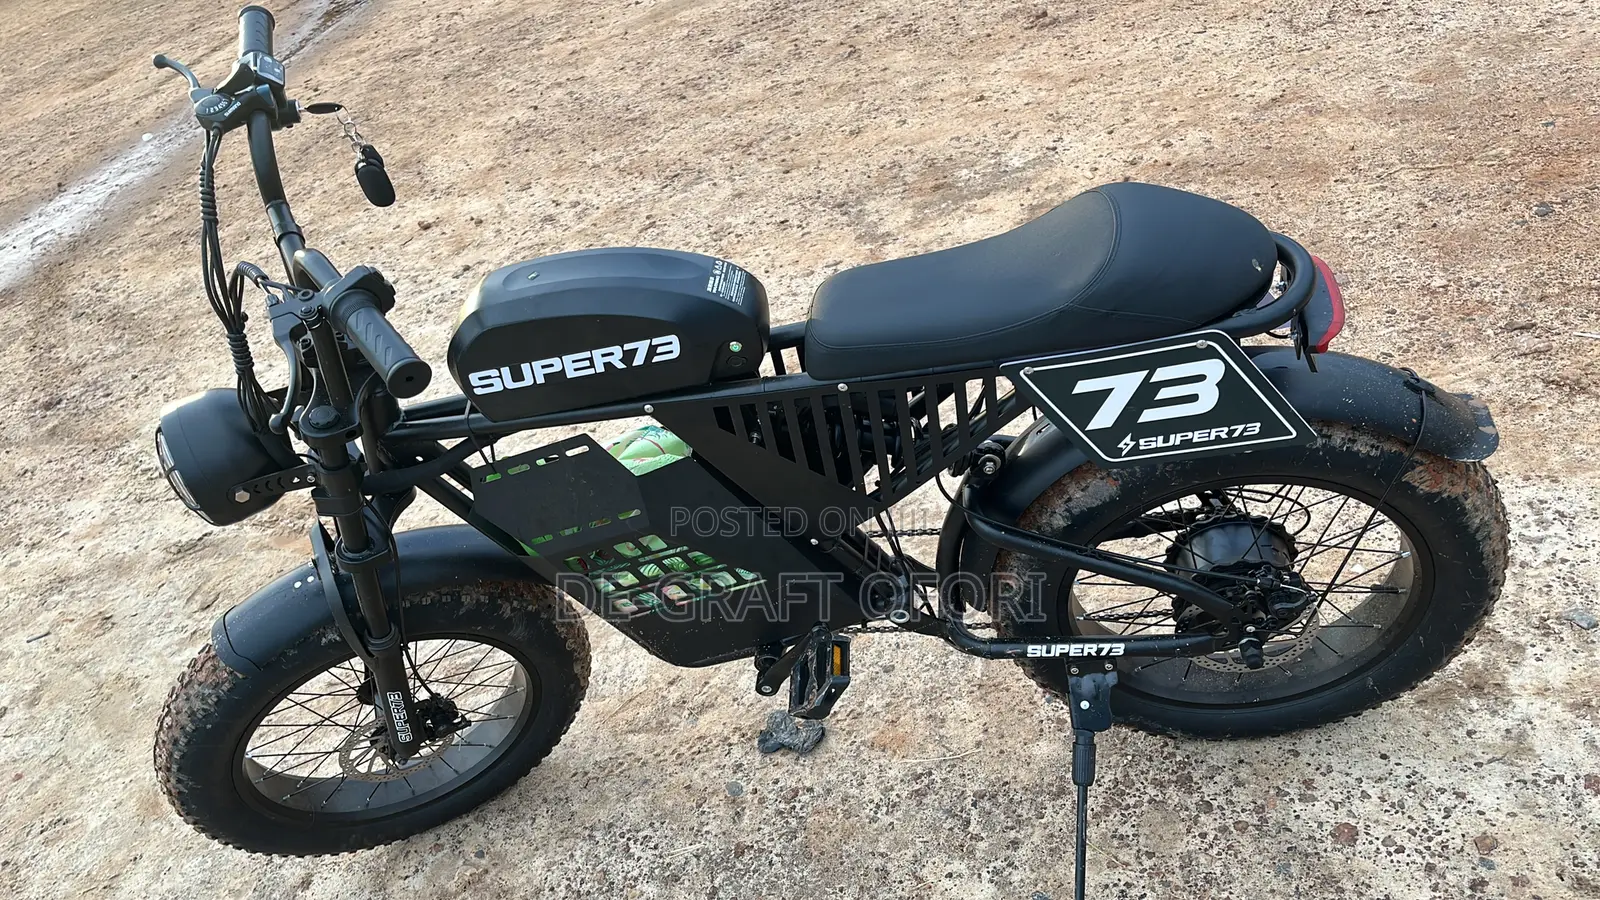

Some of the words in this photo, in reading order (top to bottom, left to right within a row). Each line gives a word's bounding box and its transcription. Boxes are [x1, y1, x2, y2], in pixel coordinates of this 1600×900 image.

[468, 334, 681, 395] SUPER73
[1071, 358, 1226, 431] 73
[1138, 422, 1262, 450] SUPER73
[1026, 642, 1126, 658] SUPER73
[387, 691, 413, 743] SUPER73
